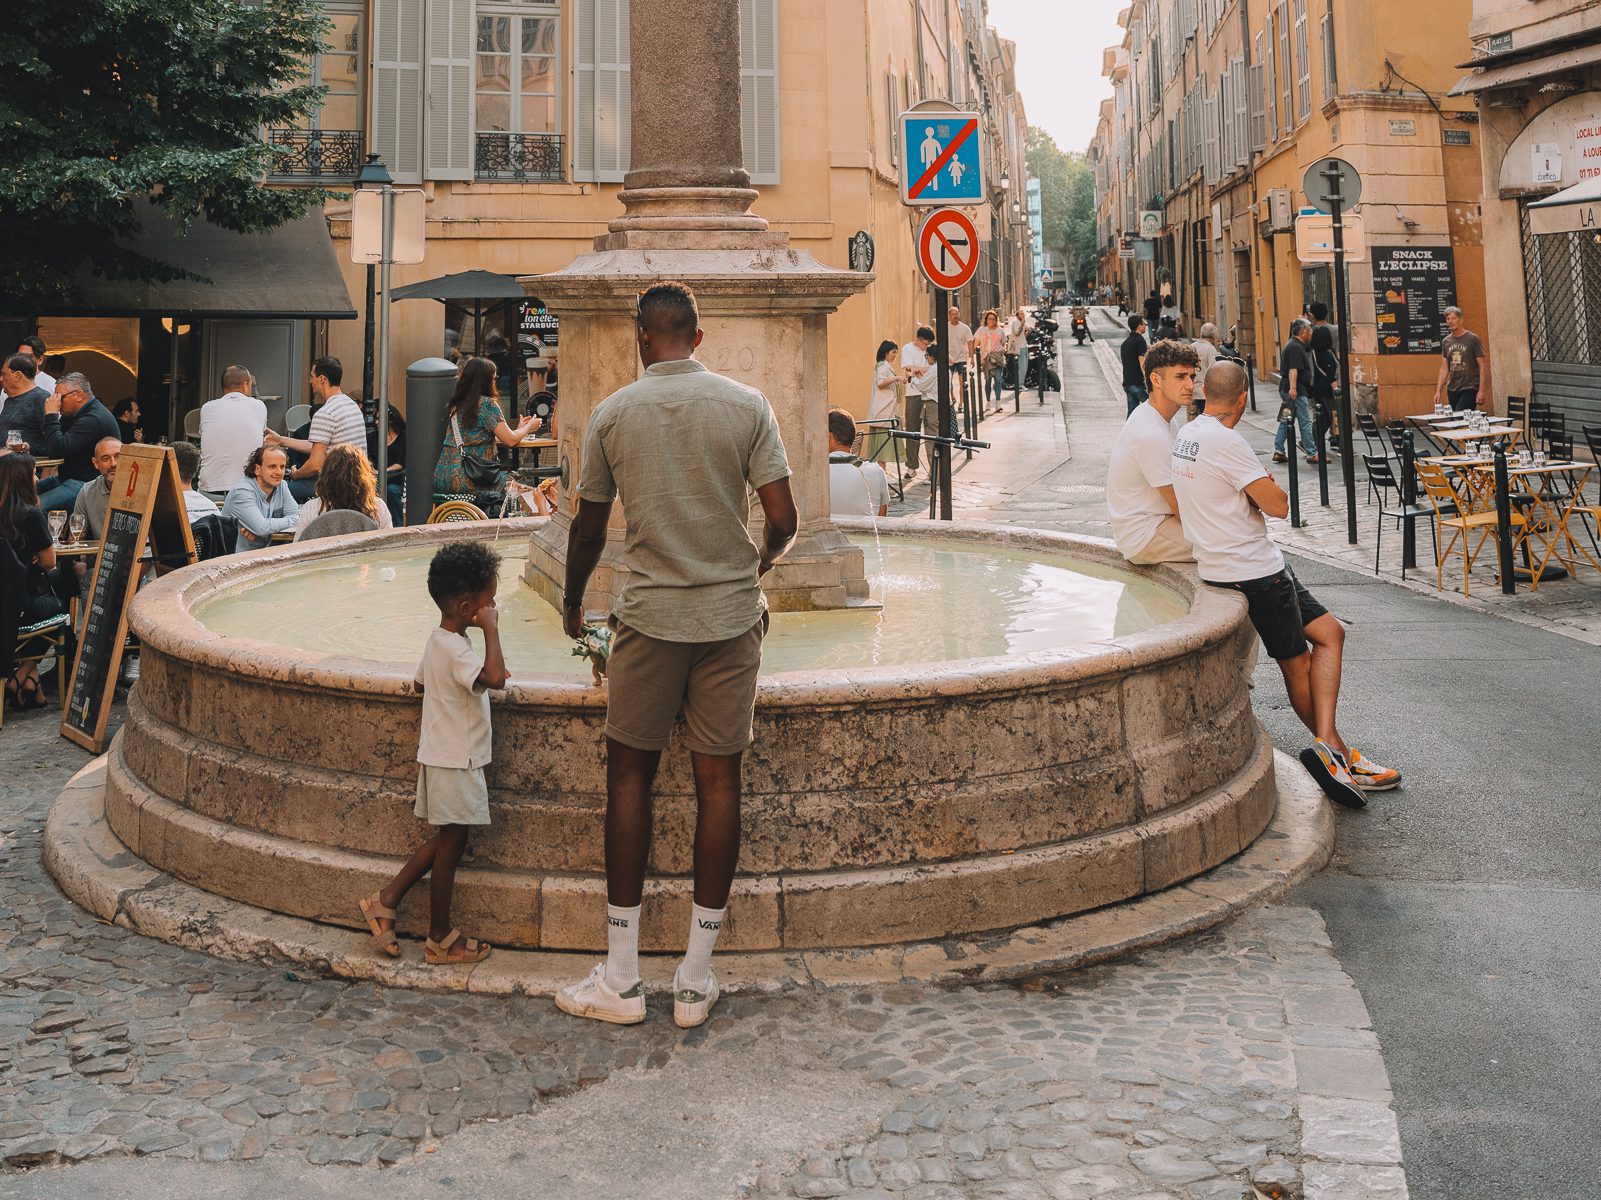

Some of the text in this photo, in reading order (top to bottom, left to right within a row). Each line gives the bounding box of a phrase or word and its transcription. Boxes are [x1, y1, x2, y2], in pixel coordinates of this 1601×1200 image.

[1576, 128, 1594, 139] LOCAL
[1580, 169, 1586, 179] 07
[1580, 208, 1595, 227] LA
[1392, 251, 1433, 259] SNACK
[1379, 261, 1448, 271] L'ECLIPSE
[608, 916, 629, 928] ANS
